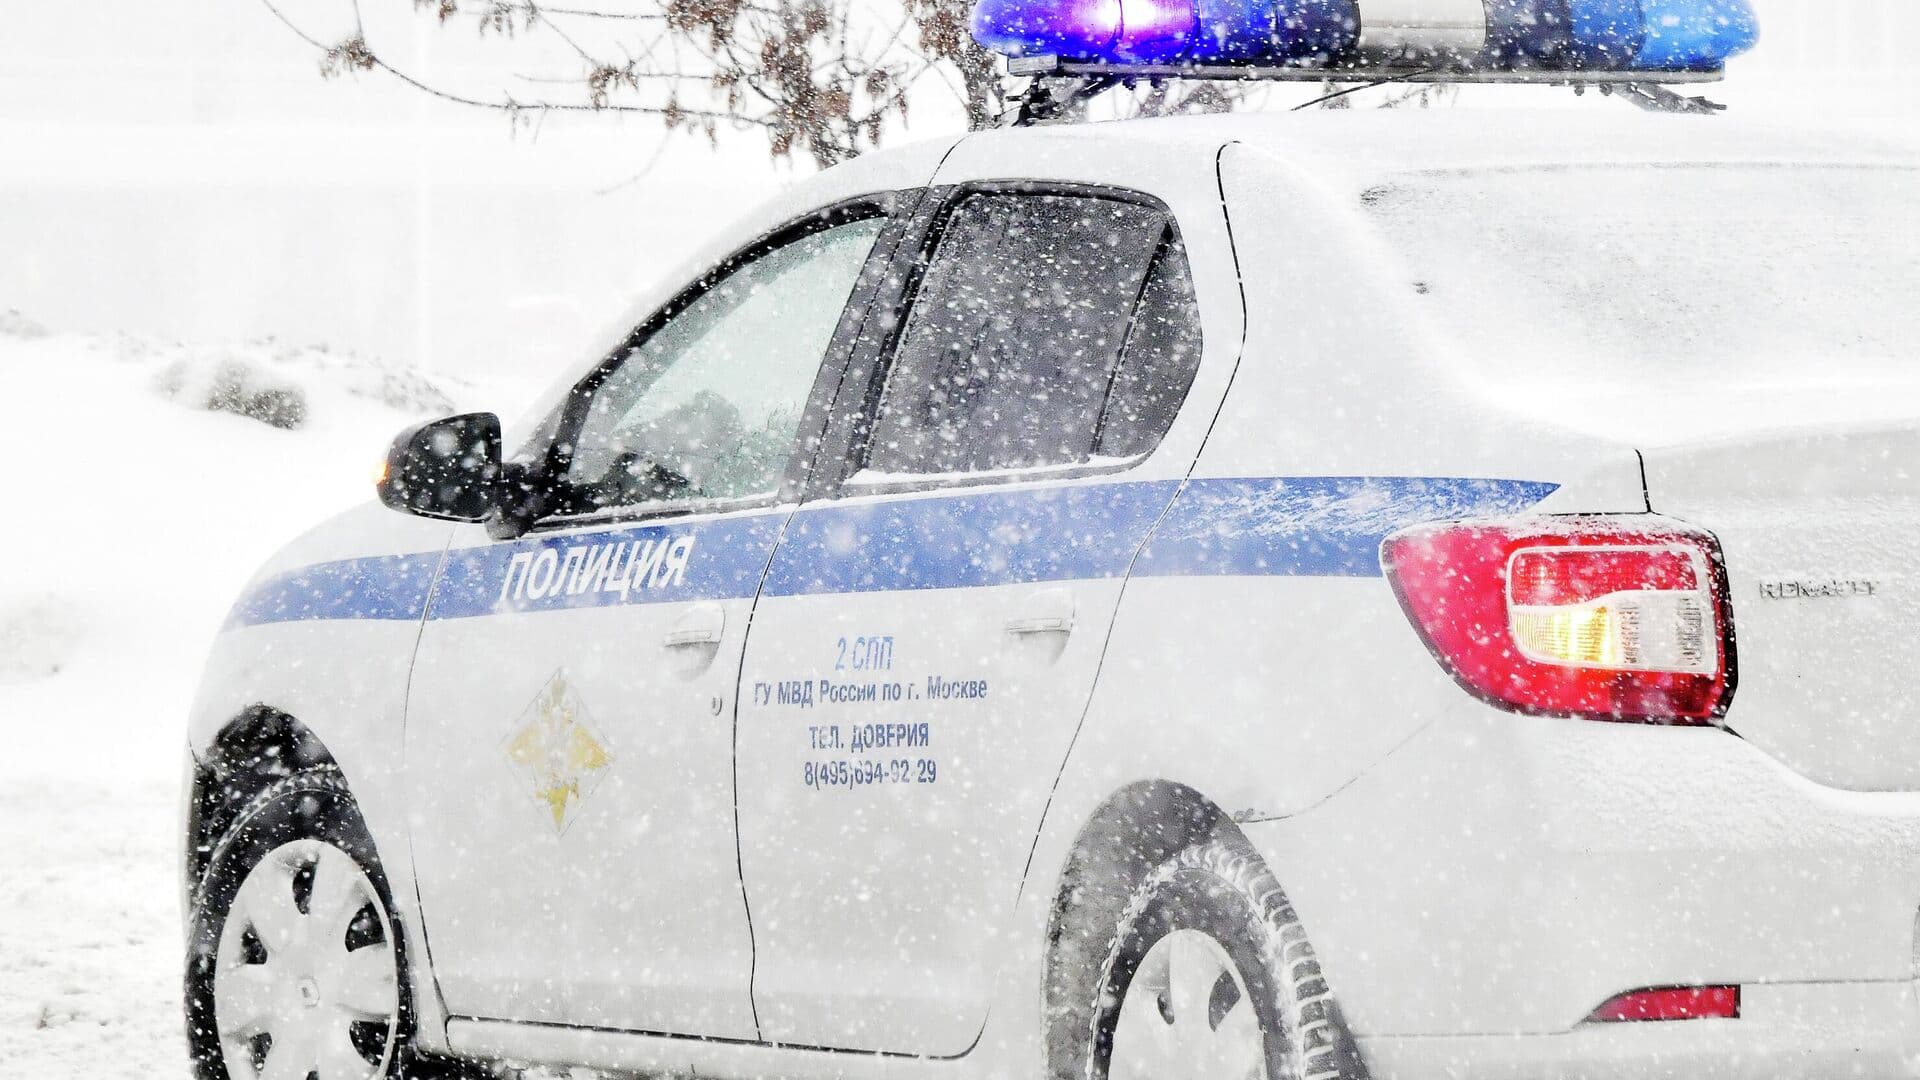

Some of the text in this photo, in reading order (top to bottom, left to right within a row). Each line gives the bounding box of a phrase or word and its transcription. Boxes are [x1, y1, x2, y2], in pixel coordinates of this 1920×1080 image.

[500, 536, 696, 604] ПОЛИЦИЯ
[834, 635, 894, 671] 2 СПП
[754, 682, 771, 705] ГУ
[777, 680, 813, 708] МВД
[820, 679, 876, 703] России
[882, 682, 901, 702] по
[927, 675, 988, 700] Москве
[809, 722, 929, 753] ТЕЛ. ДОВЕРИЯ
